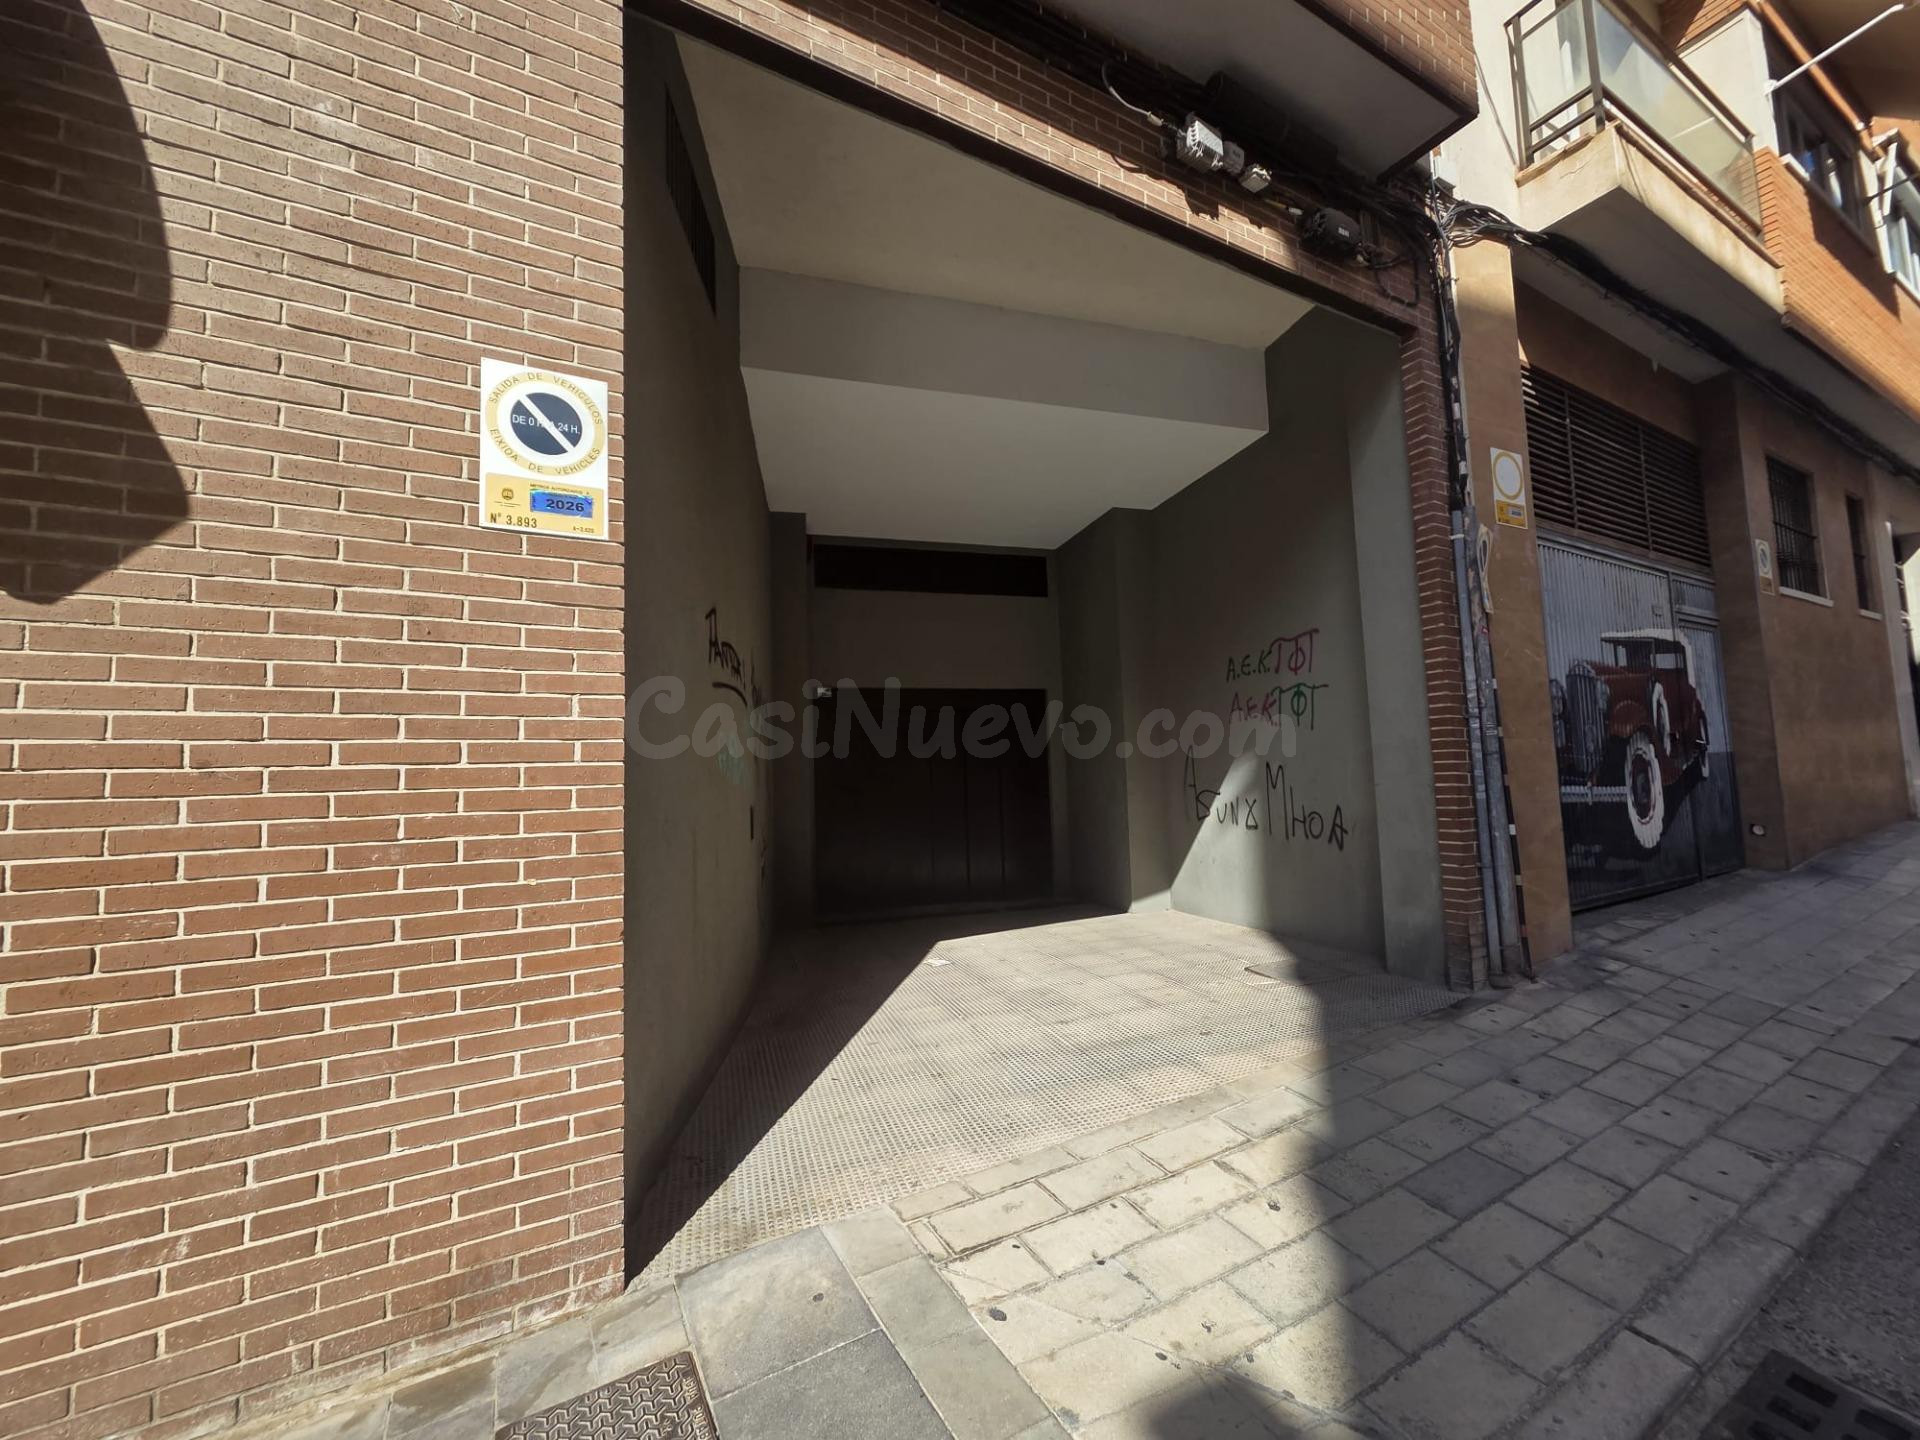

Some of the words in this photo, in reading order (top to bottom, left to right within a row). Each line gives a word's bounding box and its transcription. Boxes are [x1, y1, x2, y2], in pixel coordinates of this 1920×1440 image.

[488, 375, 520, 404] SALIDA
[527, 371, 544, 381] DE
[512, 414, 527, 426] DE
[528, 417, 536, 427] 0
[559, 422, 571, 433] 24
[489, 428, 519, 462] EIXIDA
[528, 462, 544, 473] DE
[555, 447, 601, 475] VEHICLES
[545, 498, 585, 512] 2026
[505, 514, 538, 529] 3.893
